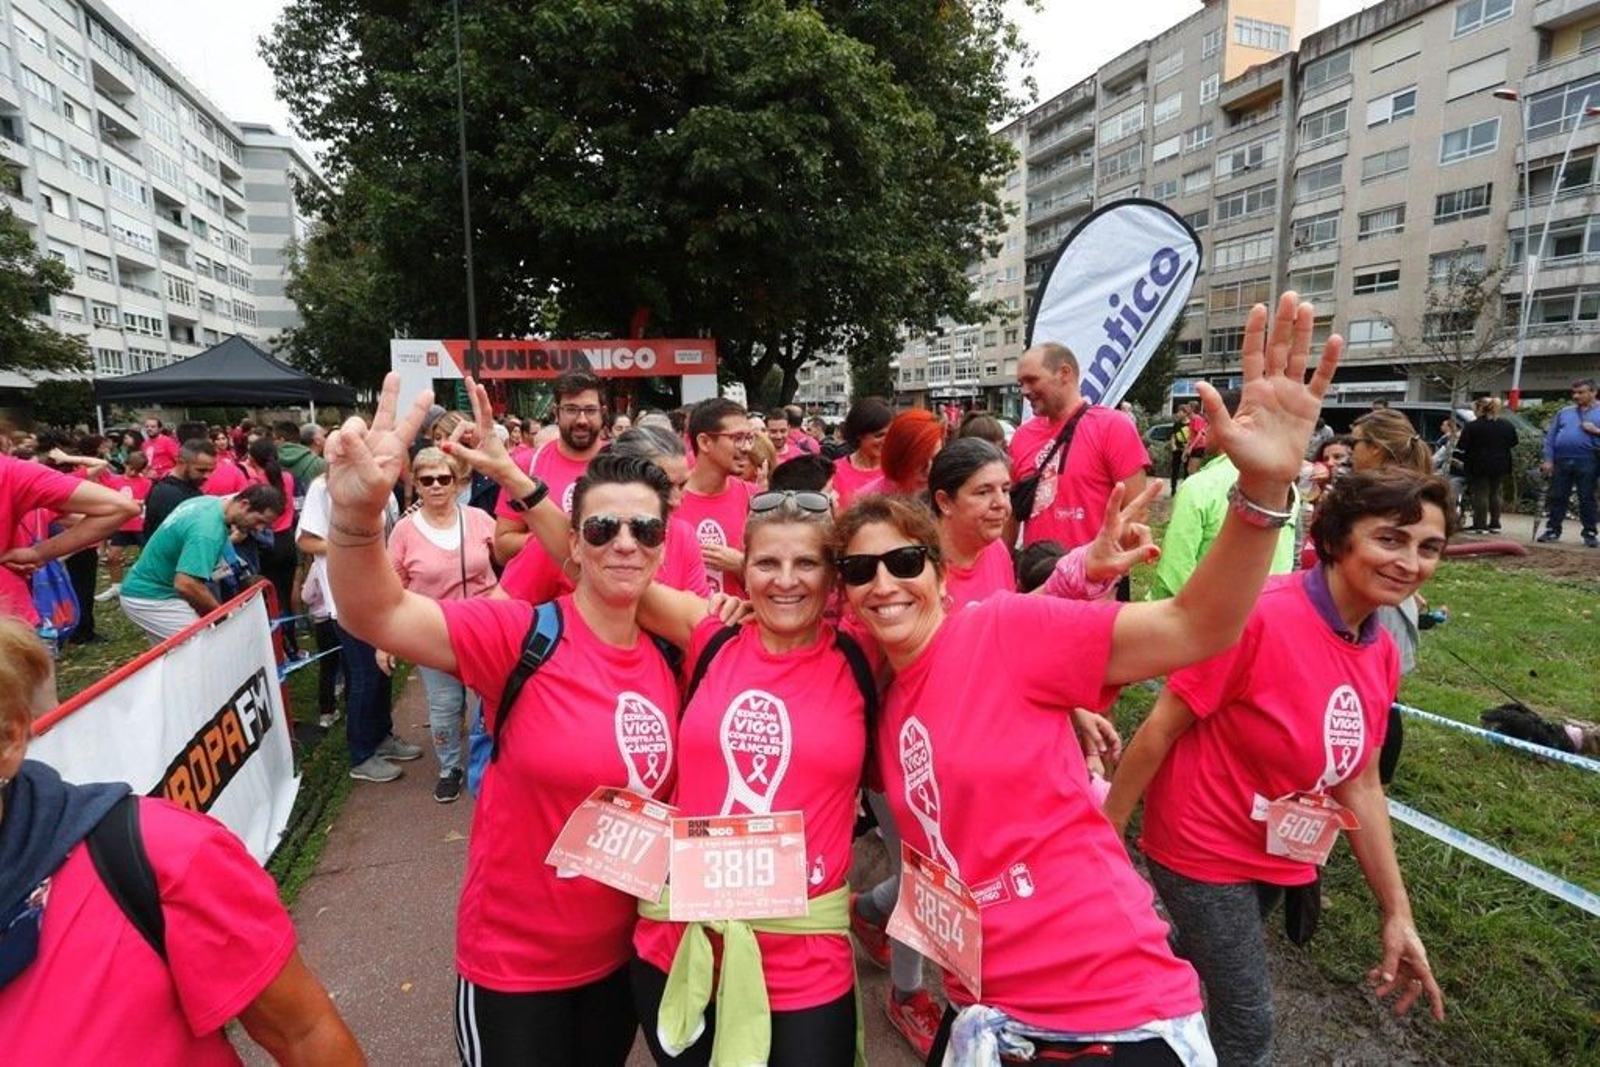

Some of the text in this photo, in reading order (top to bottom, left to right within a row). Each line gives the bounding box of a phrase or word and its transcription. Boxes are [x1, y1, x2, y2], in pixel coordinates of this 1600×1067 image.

[749, 696, 771, 711] VI
[623, 721, 662, 735] VIGO
[733, 716, 780, 736] VIGO
[1331, 717, 1360, 730] VIGO
[728, 731, 768, 744] CONTRA
[587, 814, 657, 865] 3817
[703, 847, 775, 889] 3819
[914, 883, 966, 953] 3854
